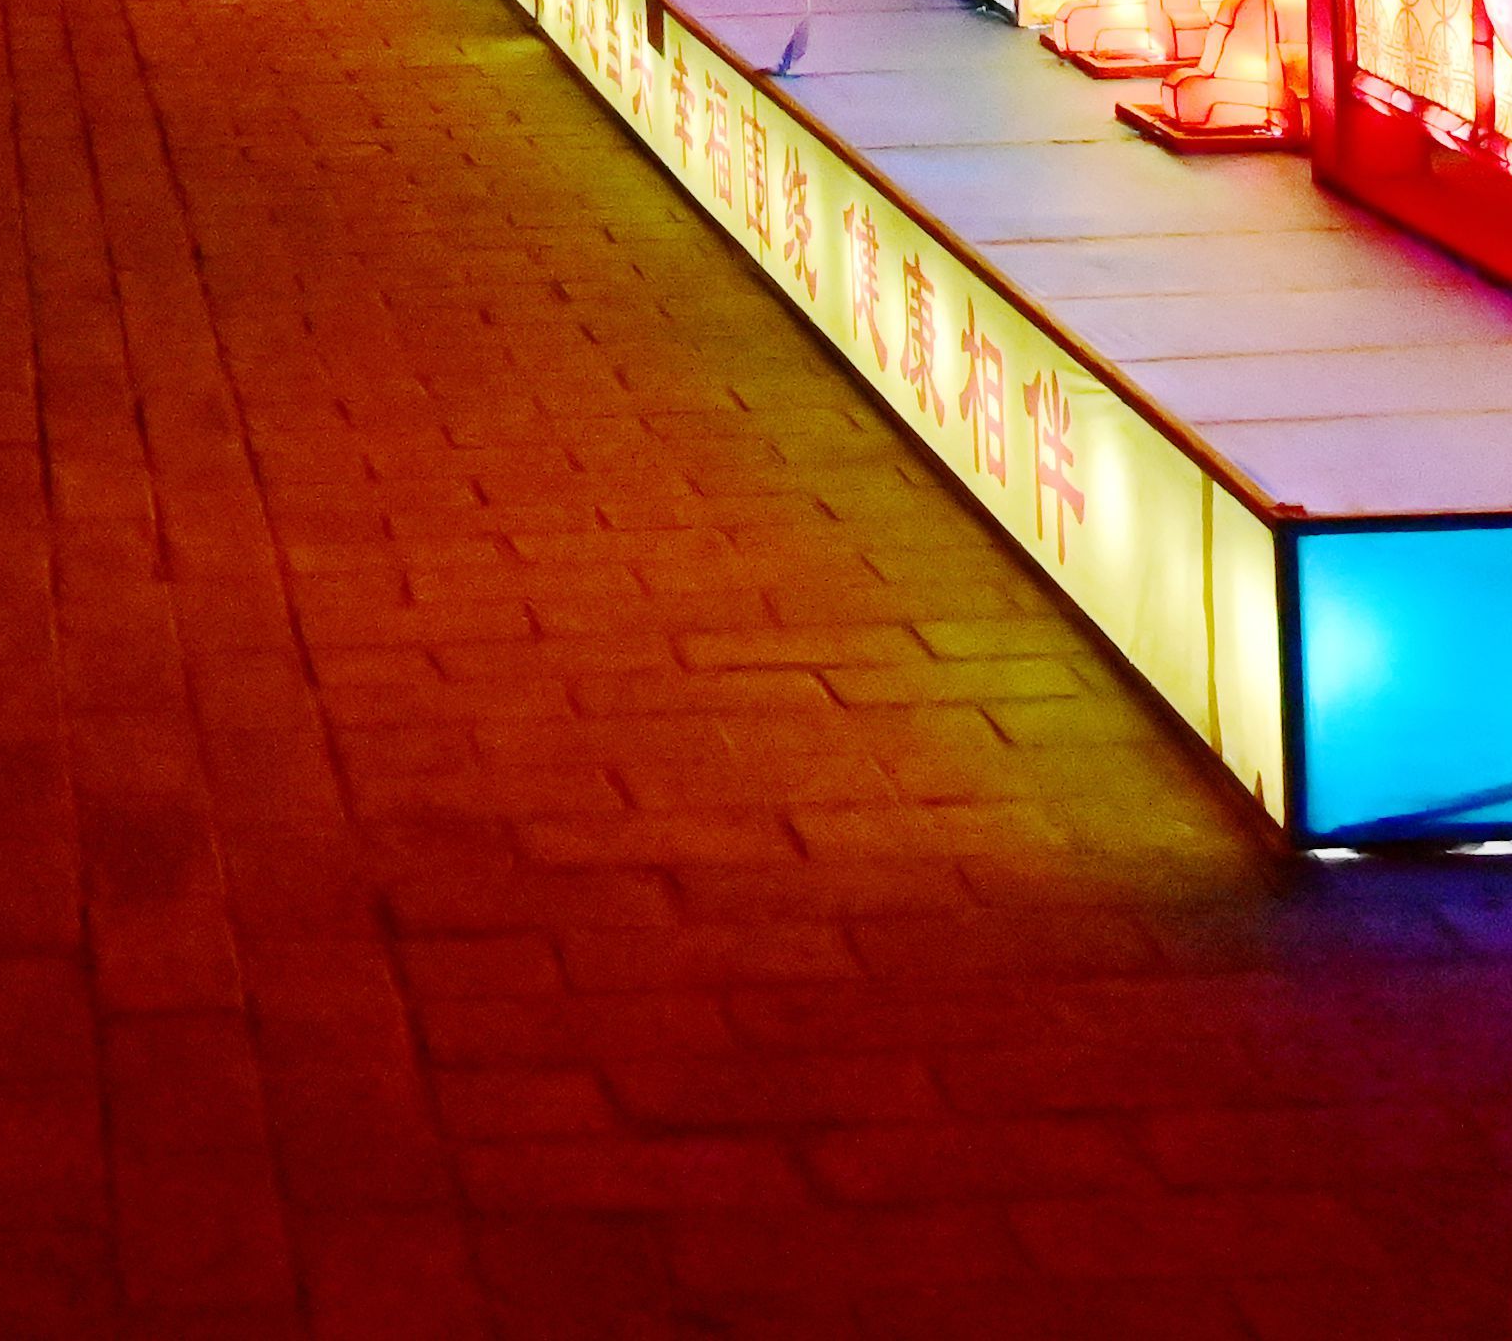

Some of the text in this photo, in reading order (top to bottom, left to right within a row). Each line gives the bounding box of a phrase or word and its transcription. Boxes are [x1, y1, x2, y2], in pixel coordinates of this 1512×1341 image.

[671, 42, 818, 302] 幸福围绕
[843, 202, 1085, 566] 健康相伴
